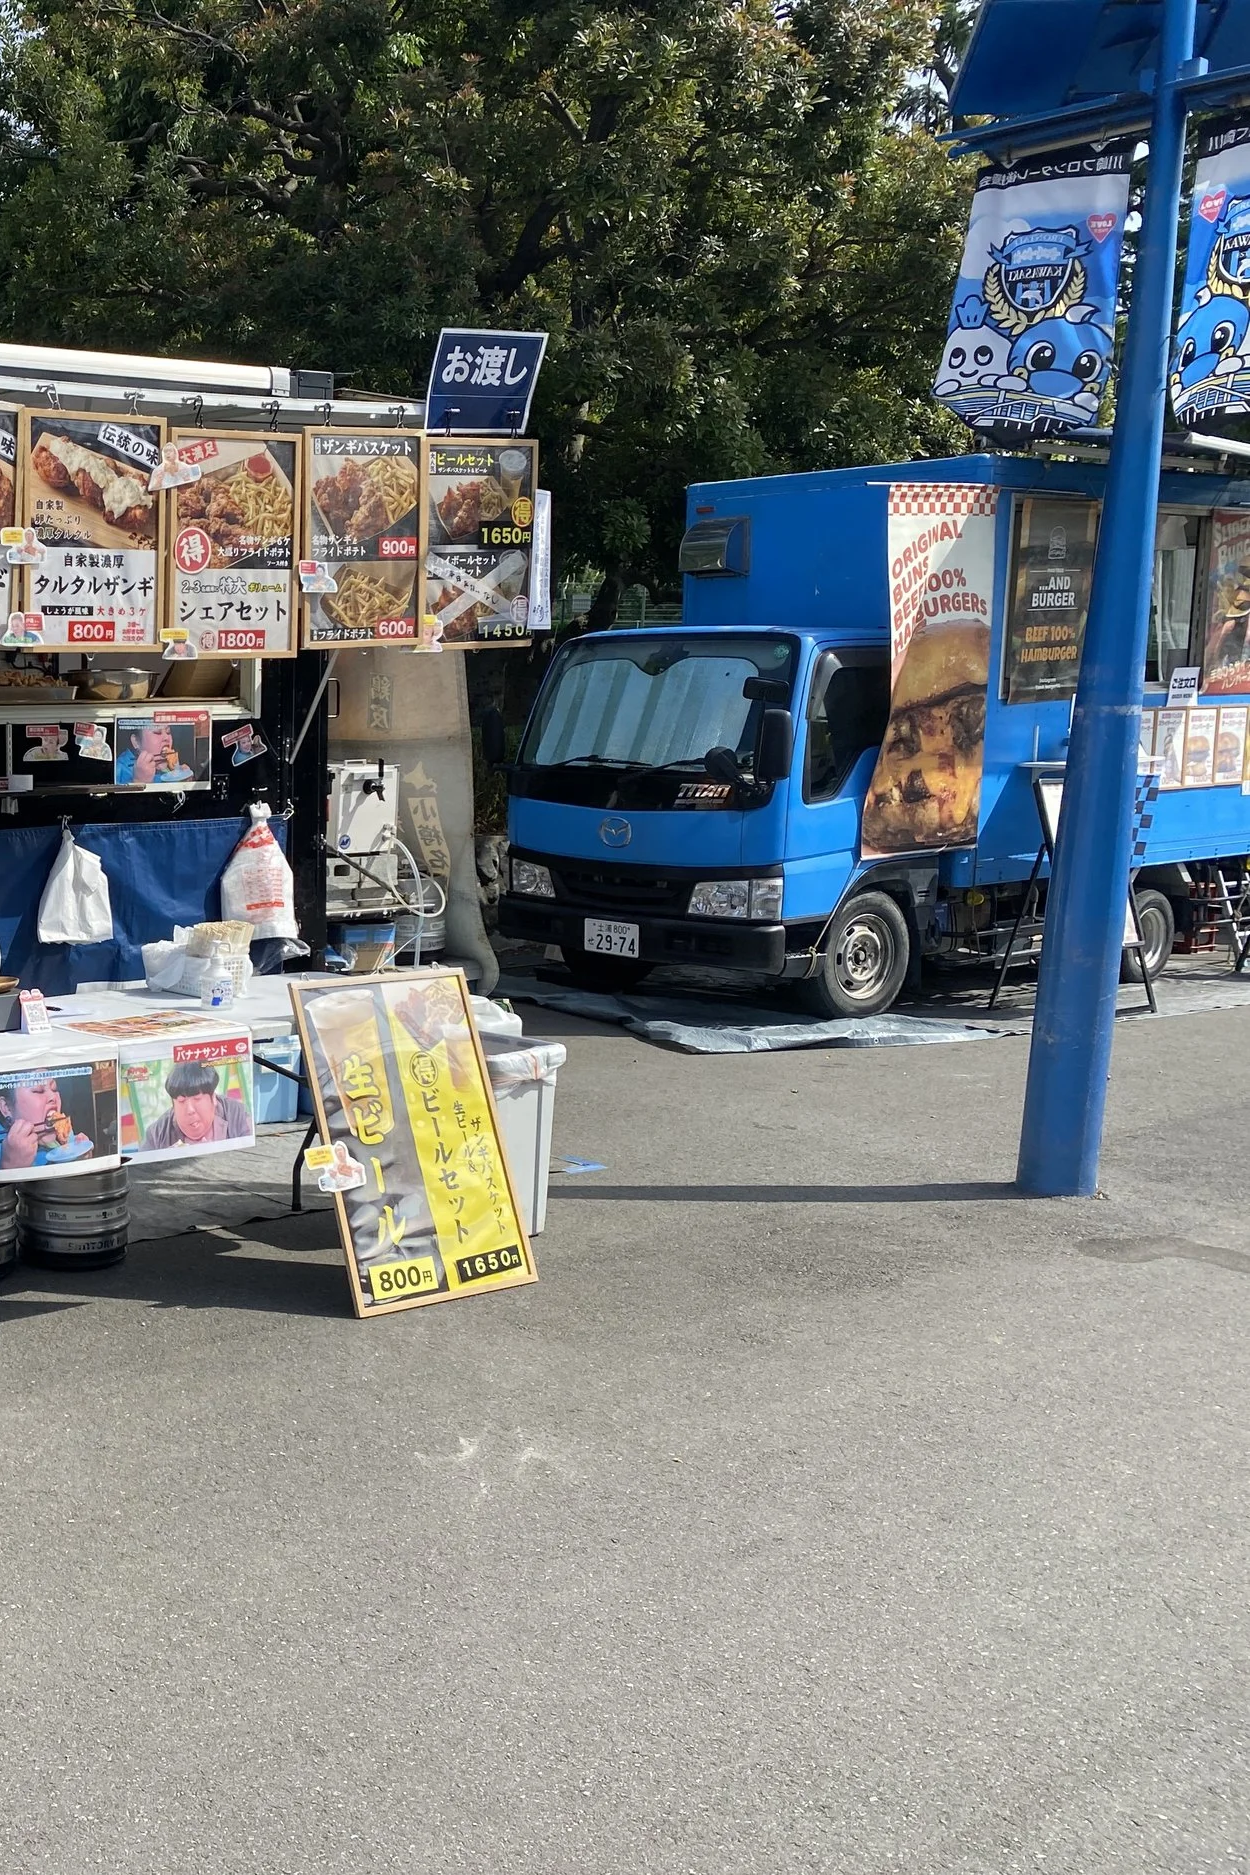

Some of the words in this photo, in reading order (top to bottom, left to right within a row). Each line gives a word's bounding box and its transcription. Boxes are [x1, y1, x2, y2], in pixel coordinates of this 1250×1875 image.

[1208, 127, 1250, 152] 川崎フ
[442, 345, 528, 386] お渡し
[101, 423, 158, 467] 伝統の味
[180, 440, 218, 464] 大満足
[322, 439, 412, 455] ザンギバスケット
[436, 453, 494, 466] ビールセット
[36, 499, 64, 512] 自家製
[34, 514, 81, 525] 卵たっぷり
[35, 527, 92, 540] 濃厚タルタル
[312, 534, 358, 545] 名物ザンギと
[481, 527, 531, 545] 1650円
[180, 533, 205, 567] 得
[217, 547, 291, 557] 大盛りフライドポテト
[312, 546, 367, 557] フライドポテト
[382, 540, 416, 555] 900円
[892, 519, 963, 579] ORIGINAL
[64, 552, 125, 569] 自家製濃厚
[34, 574, 154, 598] タルタルザンギ
[892, 555, 929, 606] BUNS
[1032, 592, 1075, 607] BURGER
[46, 606, 89, 616] しょうが風味
[179, 600, 287, 622] シェアセット
[73, 624, 114, 640] 800円
[318, 629, 374, 640] フライドポテト
[379, 620, 413, 635] 600円
[1026, 626, 1049, 643] BEEF
[1050, 625, 1075, 641] 100%
[219, 633, 264, 647] 1800円
[677, 784, 731, 798] TITAN
[613, 925, 627, 934] 800
[596, 934, 635, 955] 29-74
[177, 1045, 227, 1061] バナナサンド
[453, 1100, 479, 1174] 生ビール&
[341, 1055, 407, 1246] 生ビール
[421, 1088, 469, 1246] ビールセット
[470, 1116, 506, 1236] ザンギバスケット
[462, 1250, 520, 1277] 1650円
[379, 1266, 433, 1293] 800円
